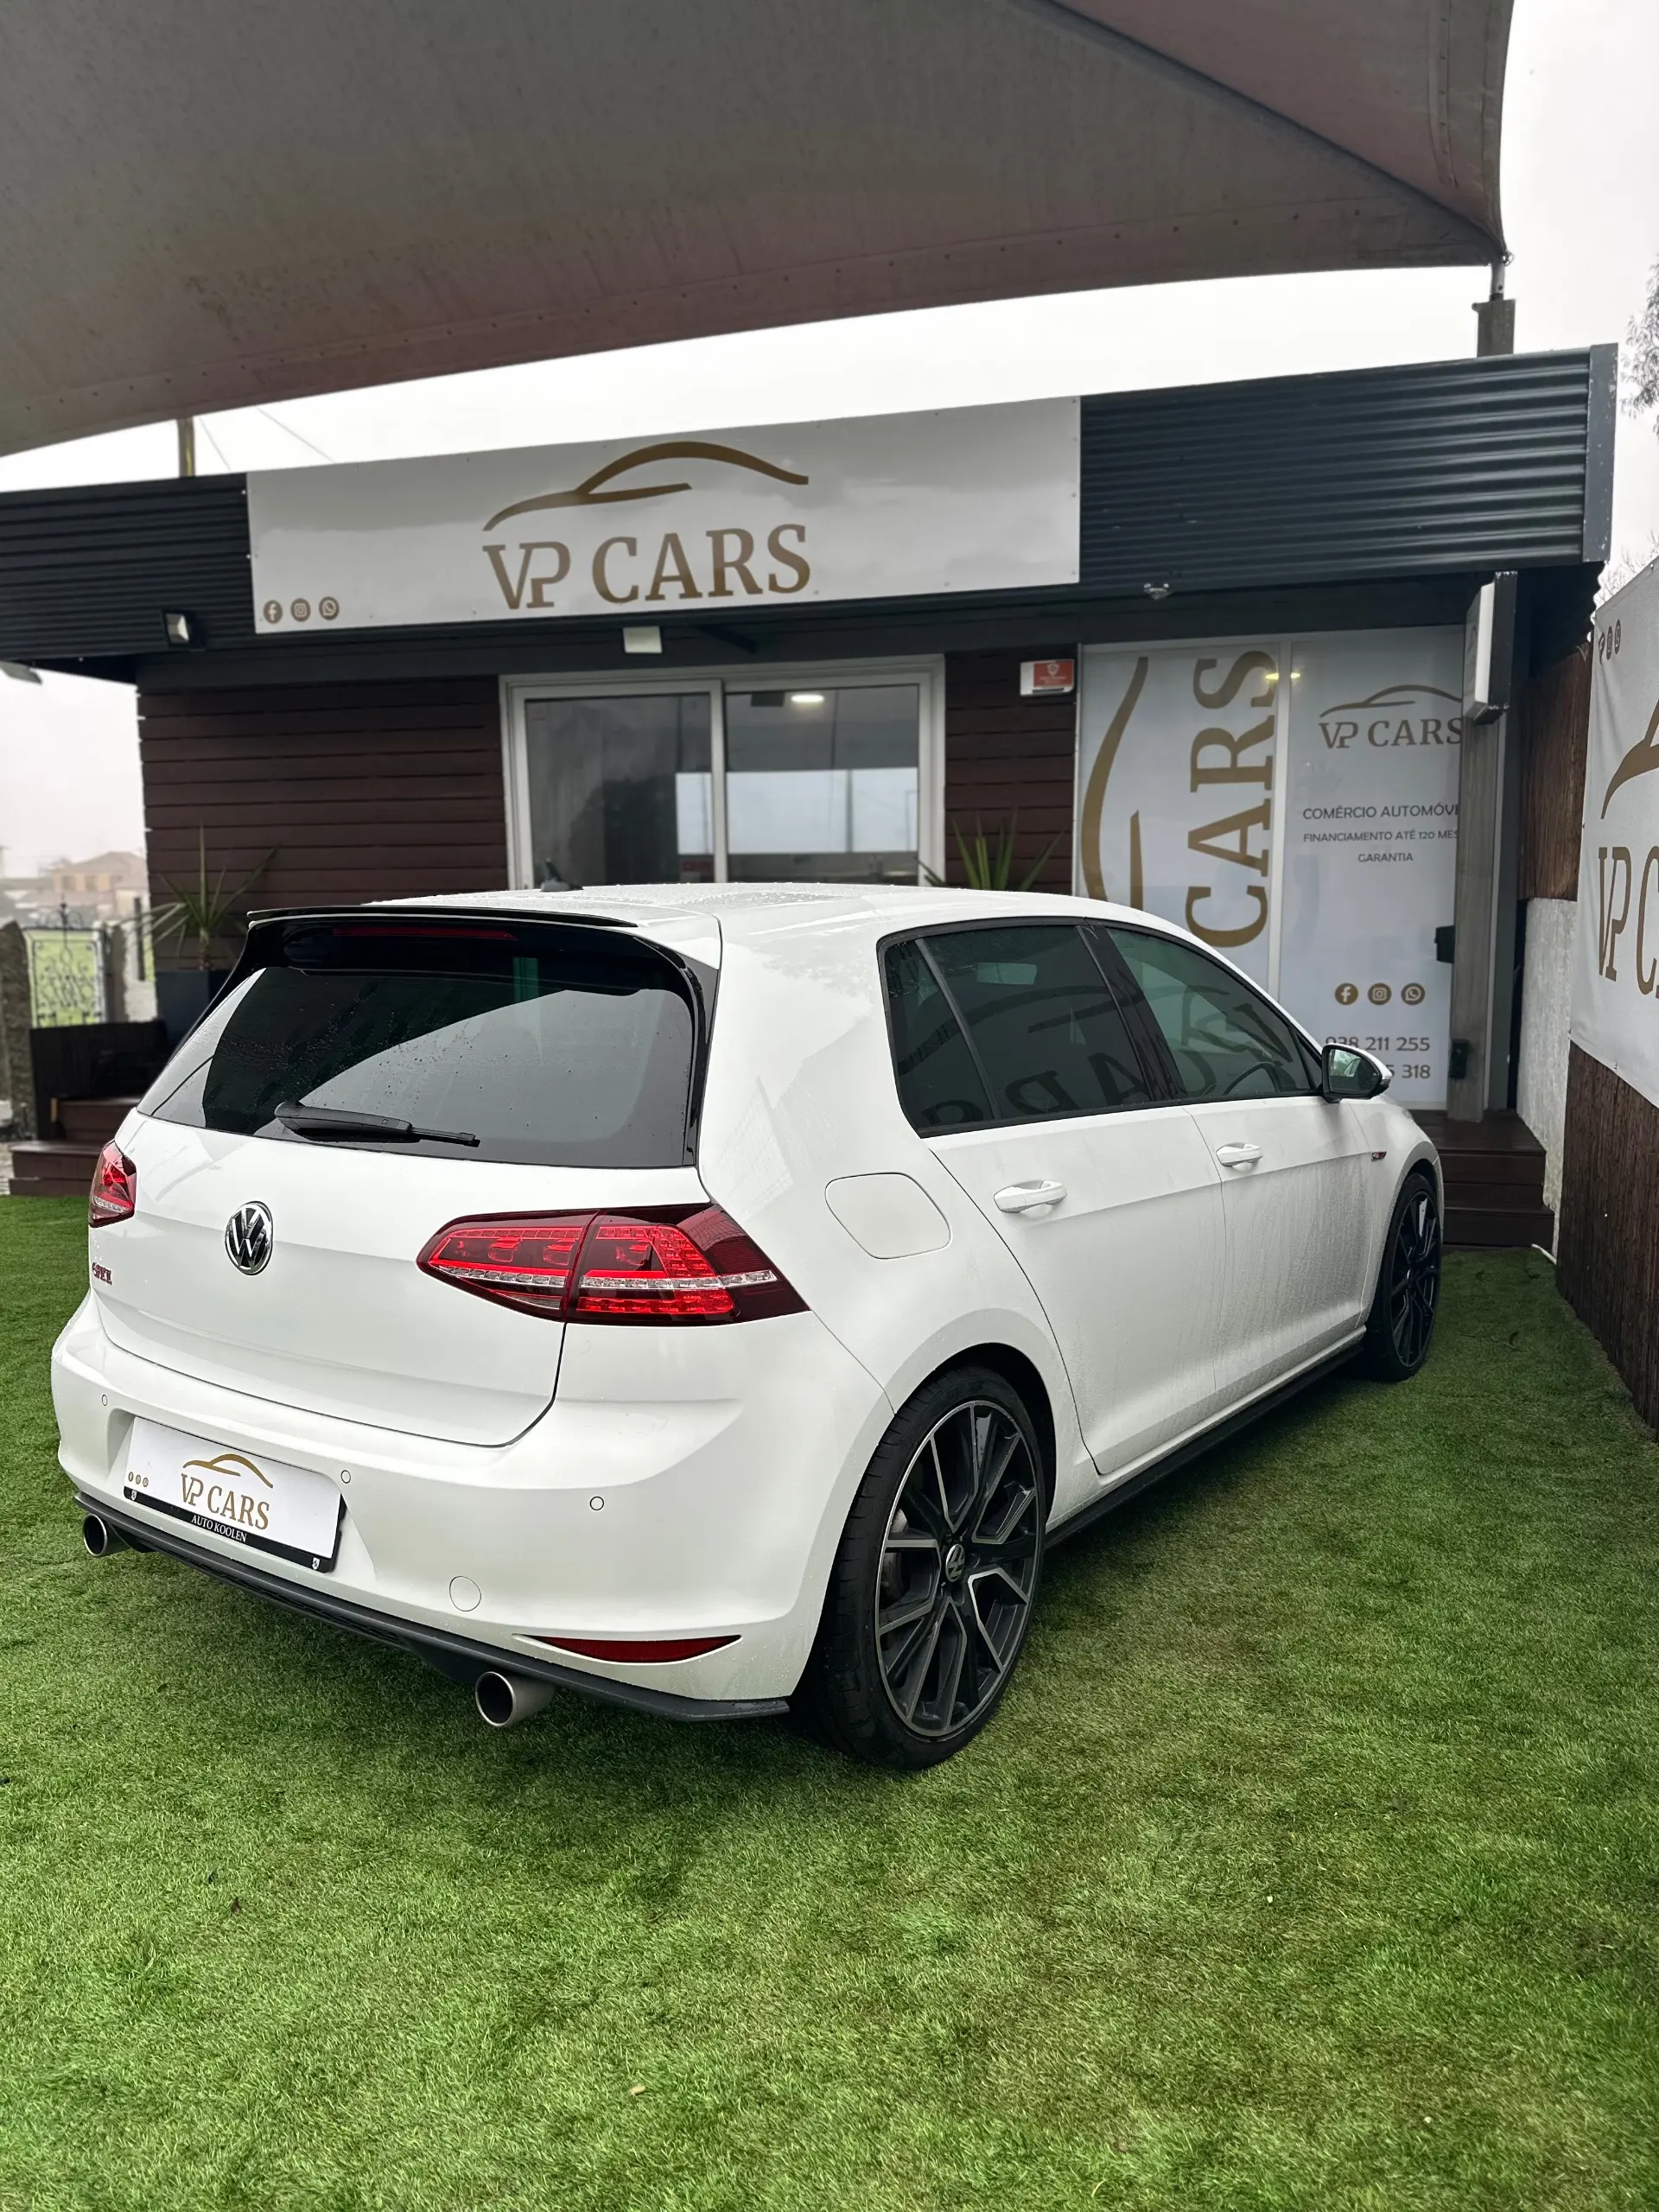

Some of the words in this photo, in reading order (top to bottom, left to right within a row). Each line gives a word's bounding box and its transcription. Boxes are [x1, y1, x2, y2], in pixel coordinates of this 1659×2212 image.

[482, 541, 571, 610] VP
[591, 524, 811, 604] CARS
[1318, 721, 1359, 749] VP
[1367, 717, 1462, 747] CARS
[1185, 650, 1278, 948] CARS
[1302, 805, 1377, 820] COMÉRCIO
[1303, 831, 1393, 842] FINANCIAMENTO
[1395, 829, 1416, 840] ATÉ
[1419, 831, 1435, 840] 120
[1357, 853, 1414, 863] GARANTIA
[1598, 846, 1631, 982] VP
[1364, 1036, 1389, 1051] 211
[1396, 1036, 1430, 1052] 255
[1402, 1064, 1431, 1079] 318
[181, 1473, 204, 1506] VP
[207, 1484, 270, 1530] CARS
[191, 1514, 213, 1530] AUTO
[213, 1522, 247, 1543] KOOLEN
